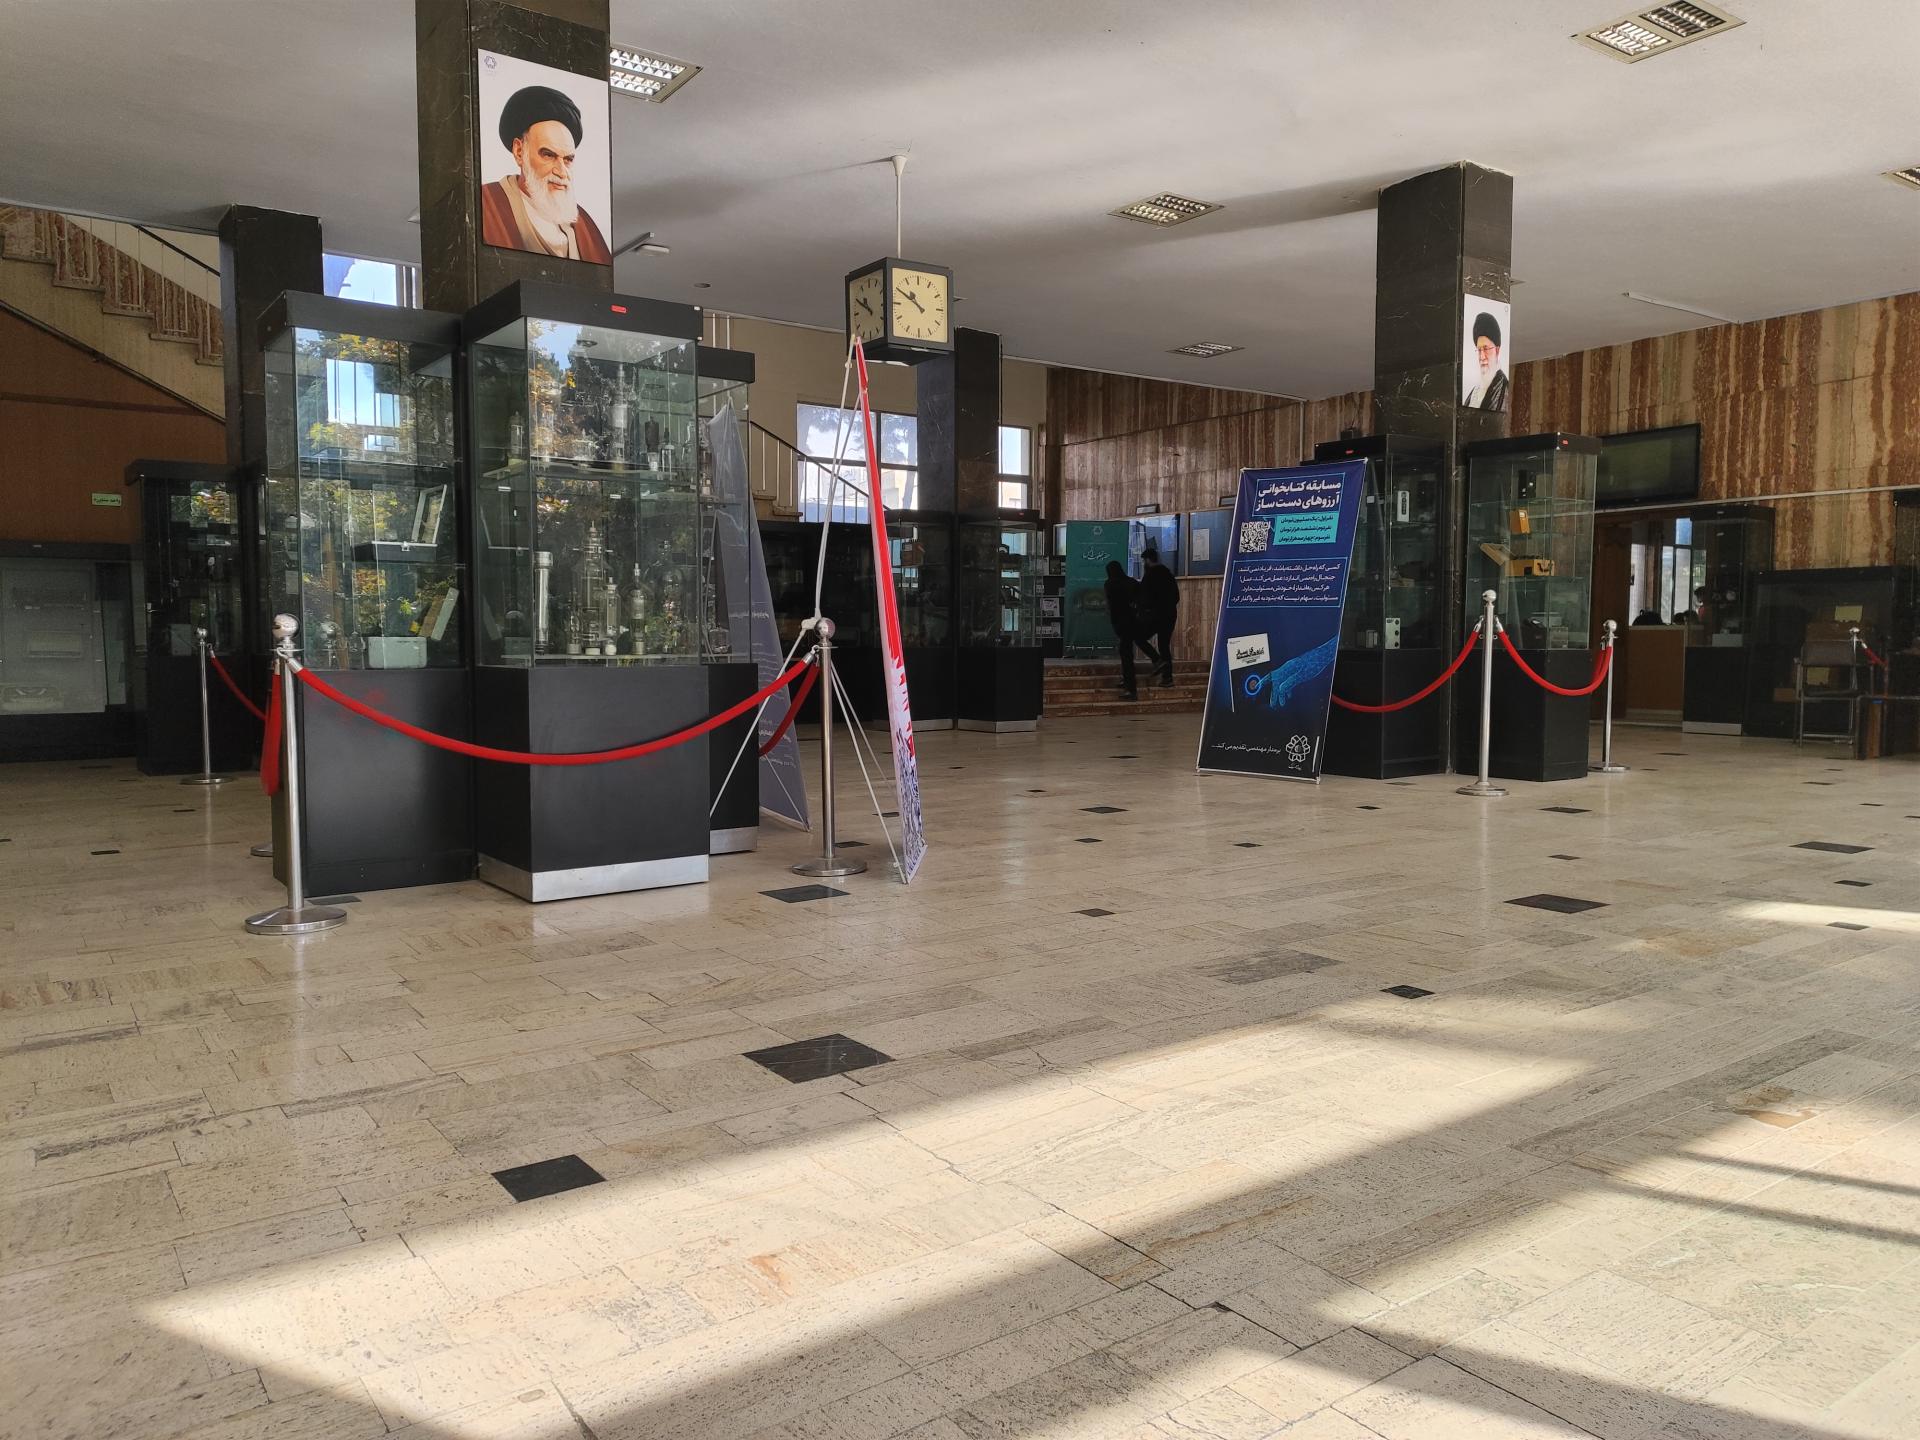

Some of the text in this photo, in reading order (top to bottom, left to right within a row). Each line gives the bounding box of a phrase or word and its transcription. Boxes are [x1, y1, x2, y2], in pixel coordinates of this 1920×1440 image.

[1258, 480, 1341, 497] مسابقه کتابخوانی
[1302, 491, 1340, 509] آرزوهای
[1325, 563, 1341, 572] کسی
[1300, 594, 1313, 603] سهام
[1232, 743, 1246, 751] تقدیم
[1246, 745, 1266, 753] مهندسی
